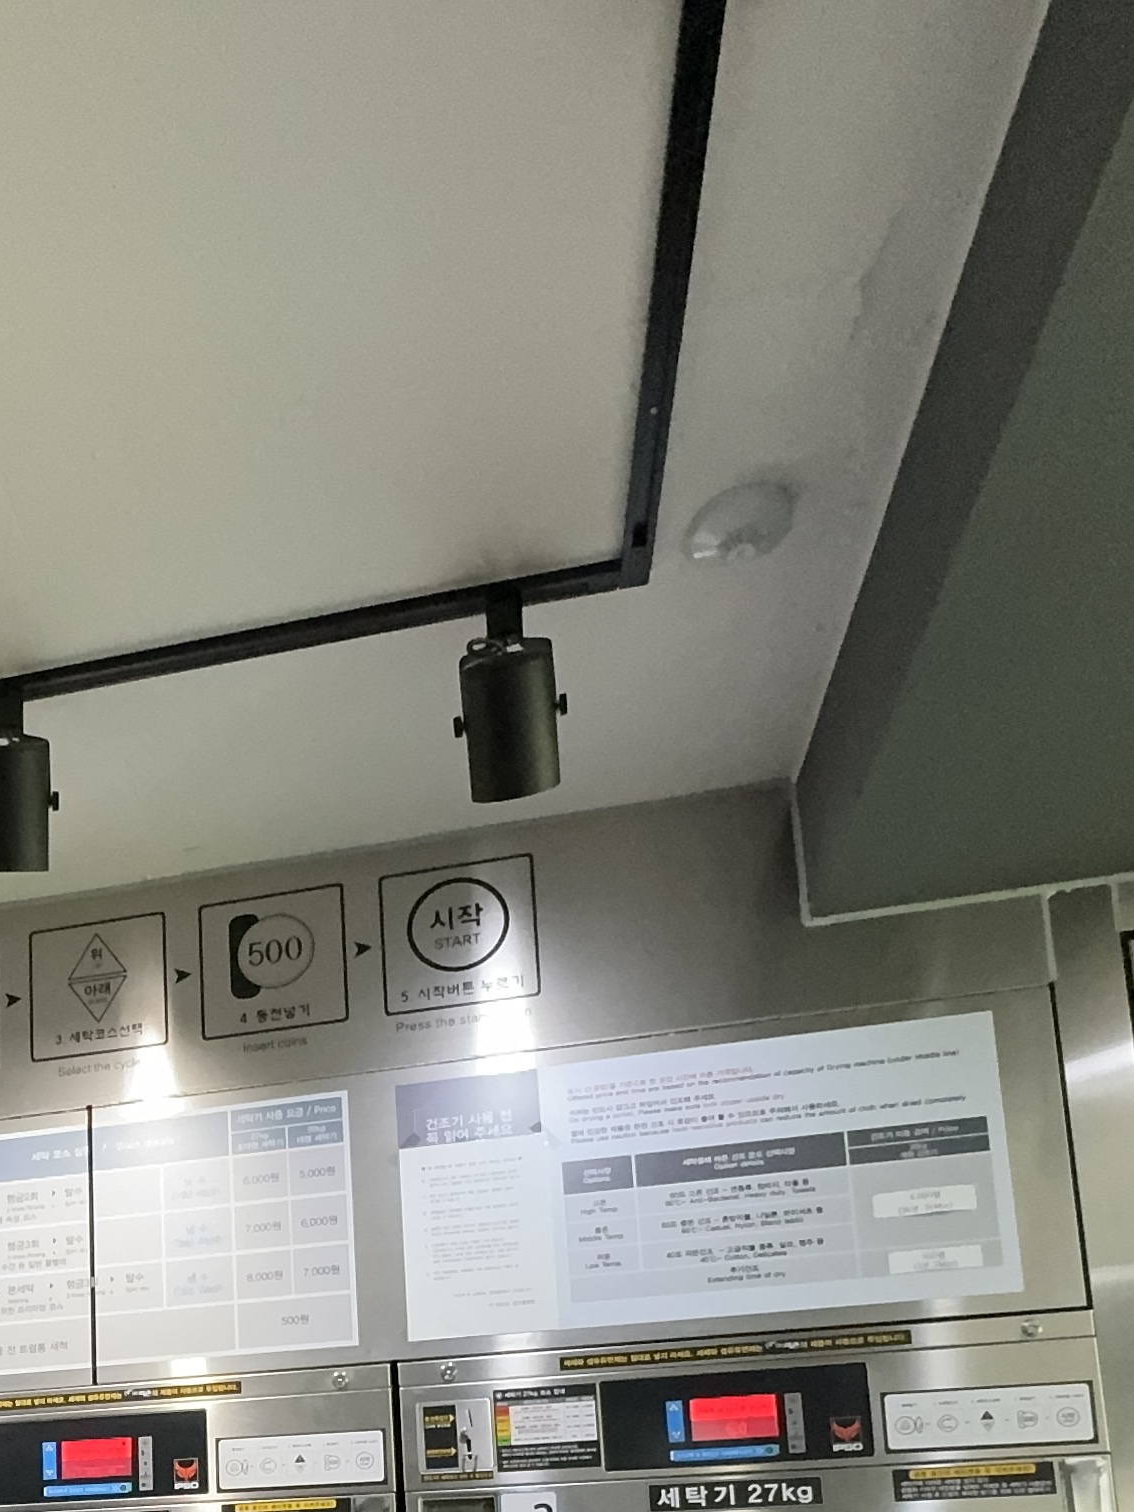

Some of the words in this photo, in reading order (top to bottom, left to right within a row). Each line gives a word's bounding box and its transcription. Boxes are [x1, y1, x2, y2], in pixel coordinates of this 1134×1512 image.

[430, 903, 483, 930] 시작
[435, 933, 480, 950] START
[248, 936, 302, 967] 500
[84, 982, 111, 996] 아래
[418, 981, 475, 1001] 시작버튼
[256, 1003, 311, 1023] 동전넣기
[70, 1023, 143, 1043] 세탁코스선택
[396, 1022, 431, 1033] Press
[436, 1017, 455, 1028] the
[460, 1014, 487, 1025] star
[243, 1041, 274, 1052] Insert
[278, 1037, 307, 1049] coins
[58, 1064, 92, 1077] Select
[94, 1062, 111, 1072] the
[426, 1115, 463, 1130] 건조기
[469, 1111, 494, 1125] 사용
[443, 1128, 469, 1143] 읽어
[280, 1313, 310, 1326] 500원
[657, 1484, 735, 1508] 세탁기
[747, 1483, 813, 1503] 27kg
